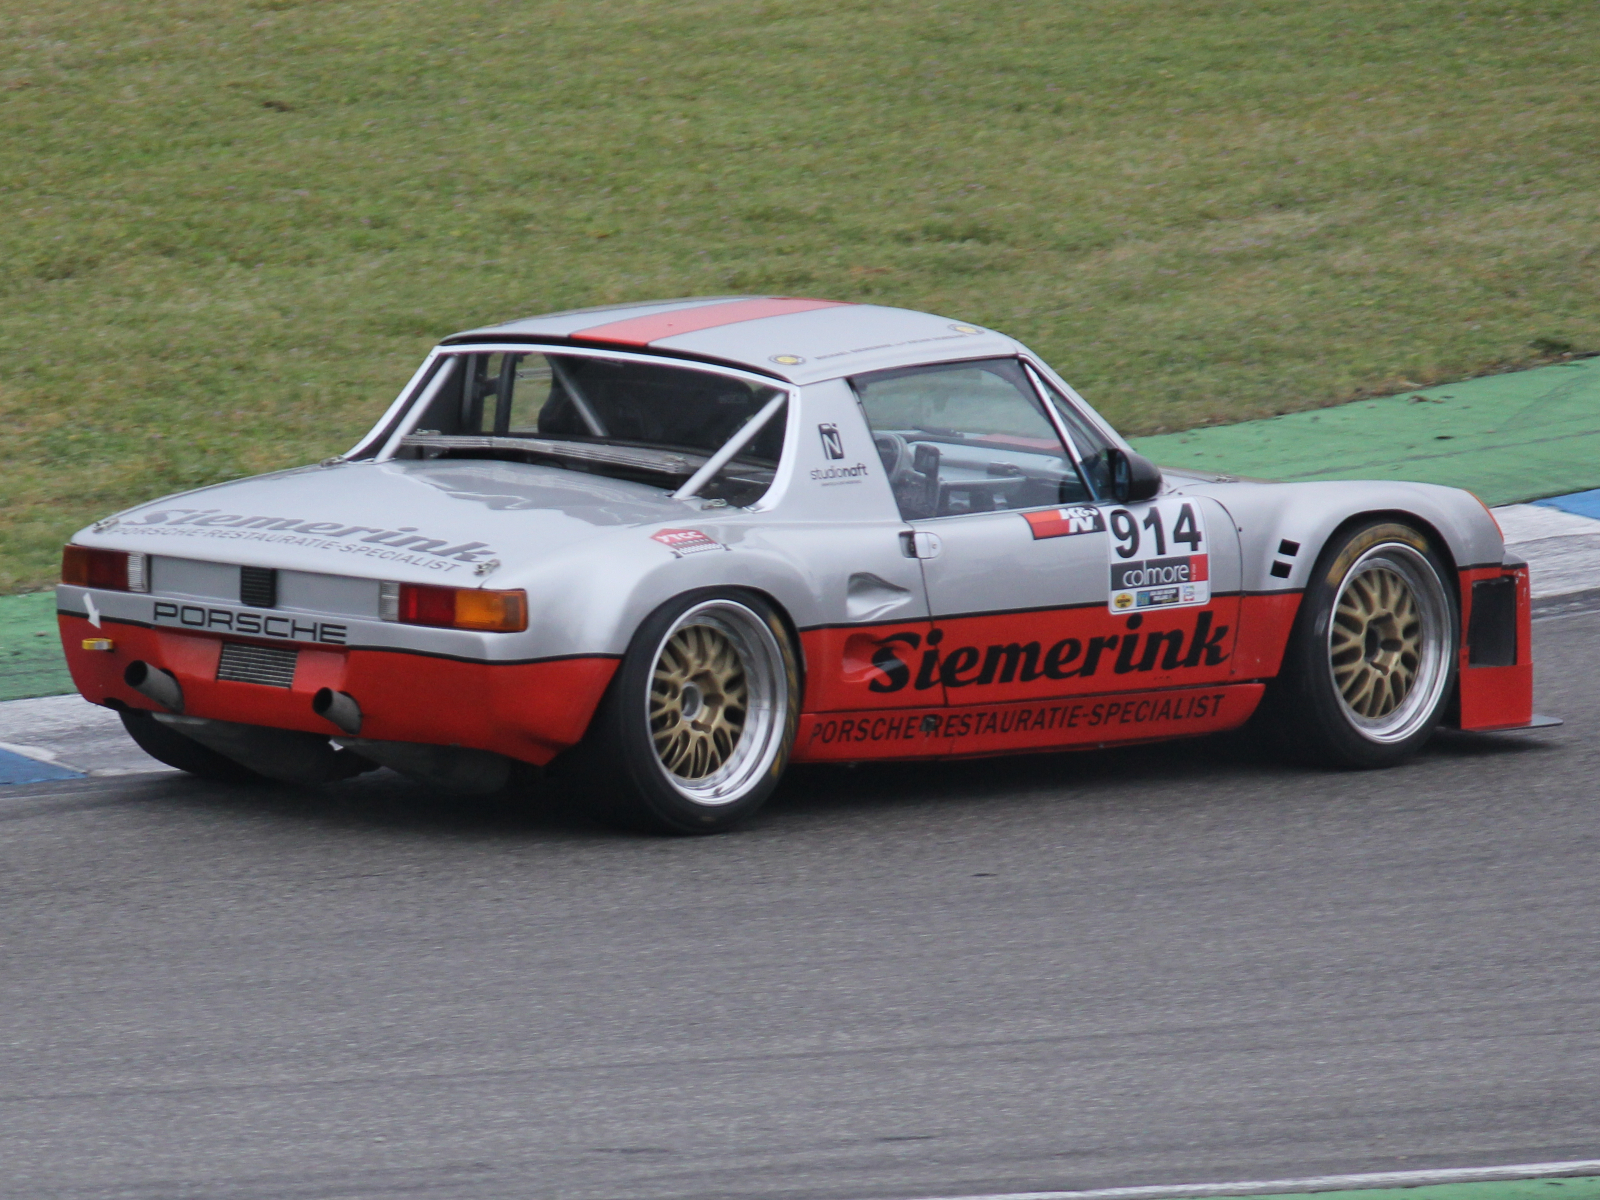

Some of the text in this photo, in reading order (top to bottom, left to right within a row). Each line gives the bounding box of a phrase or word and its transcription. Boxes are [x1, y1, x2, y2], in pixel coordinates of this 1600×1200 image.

[810, 462, 868, 480] studionaft
[123, 508, 497, 563] Siemerink
[1110, 503, 1203, 559] 914
[1123, 559, 1190, 588] colmore
[153, 602, 347, 645] PORSCHE
[868, 611, 1230, 694] Siemerink
[808, 694, 1226, 745] PORSCHERESTAURATIE-SPECIALIST
